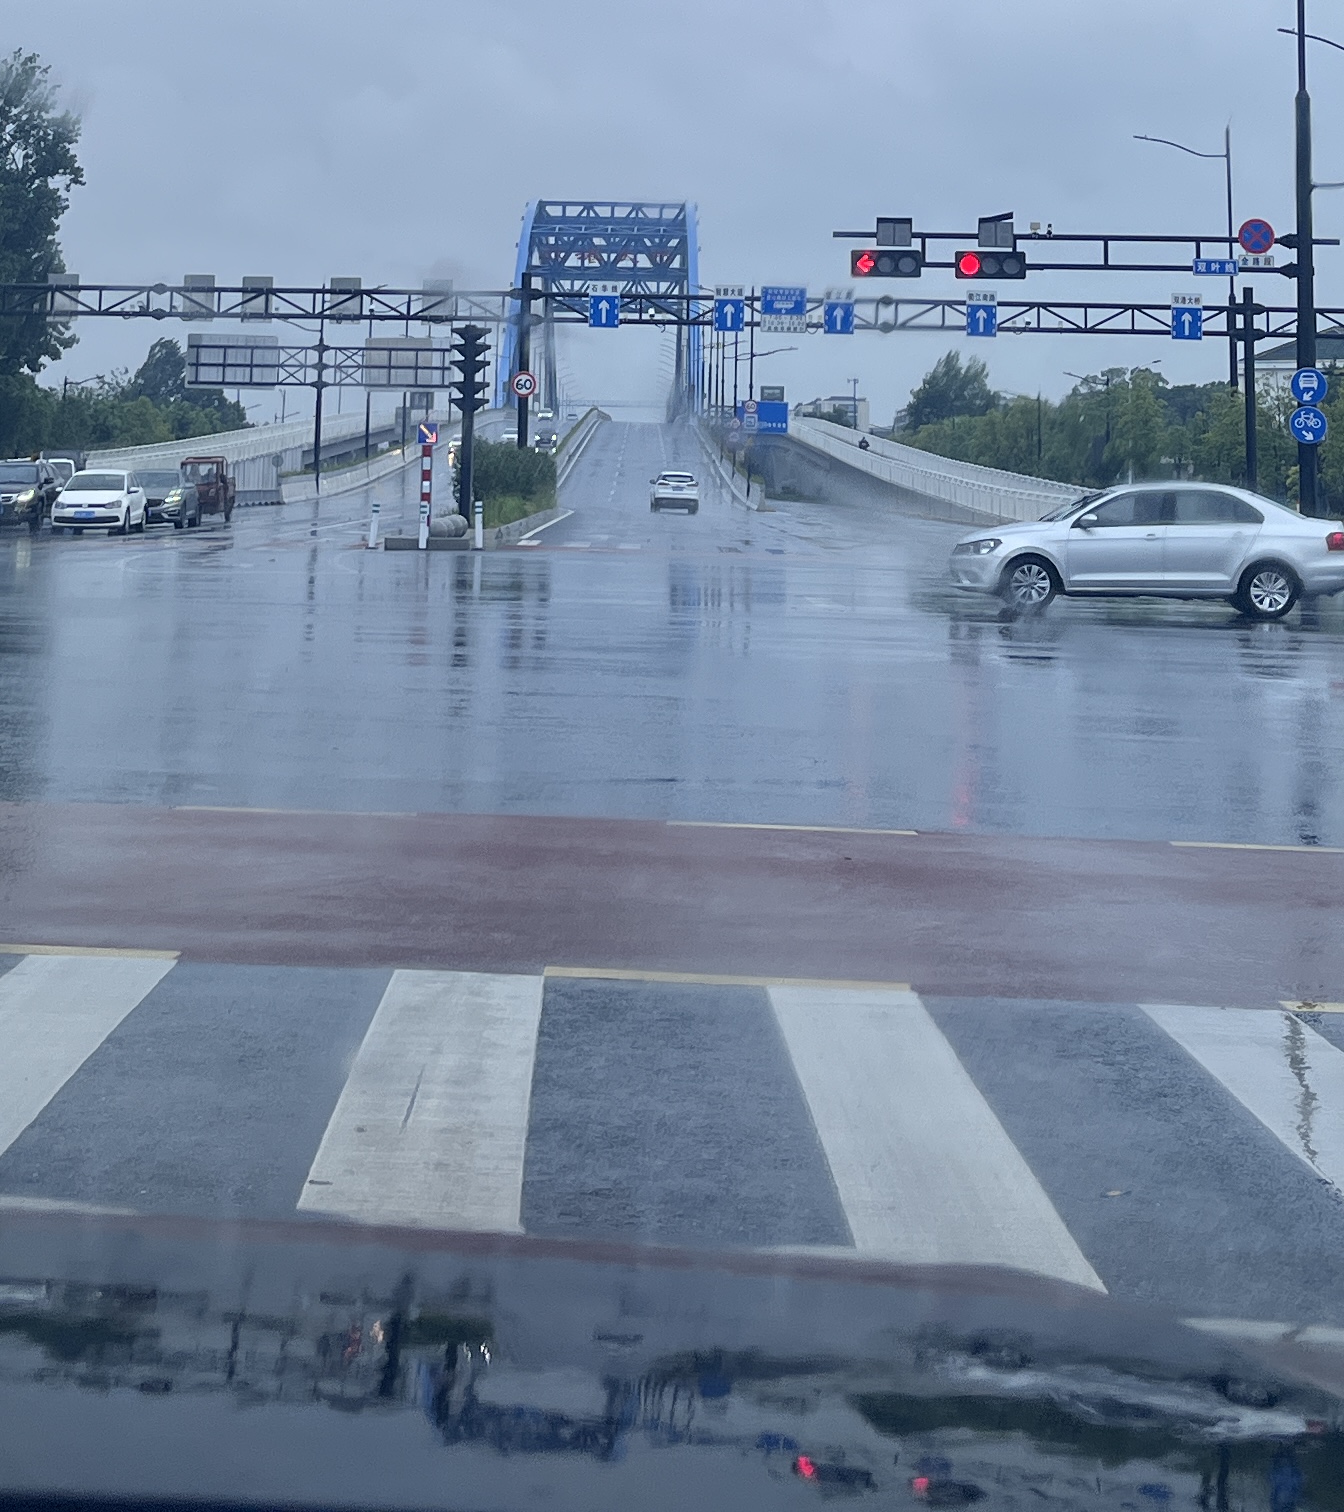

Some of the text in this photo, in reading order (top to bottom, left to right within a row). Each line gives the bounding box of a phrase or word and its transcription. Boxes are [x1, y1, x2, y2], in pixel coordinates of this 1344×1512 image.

[1241, 257, 1271, 266] 全路段
[516, 378, 533, 390] 60
